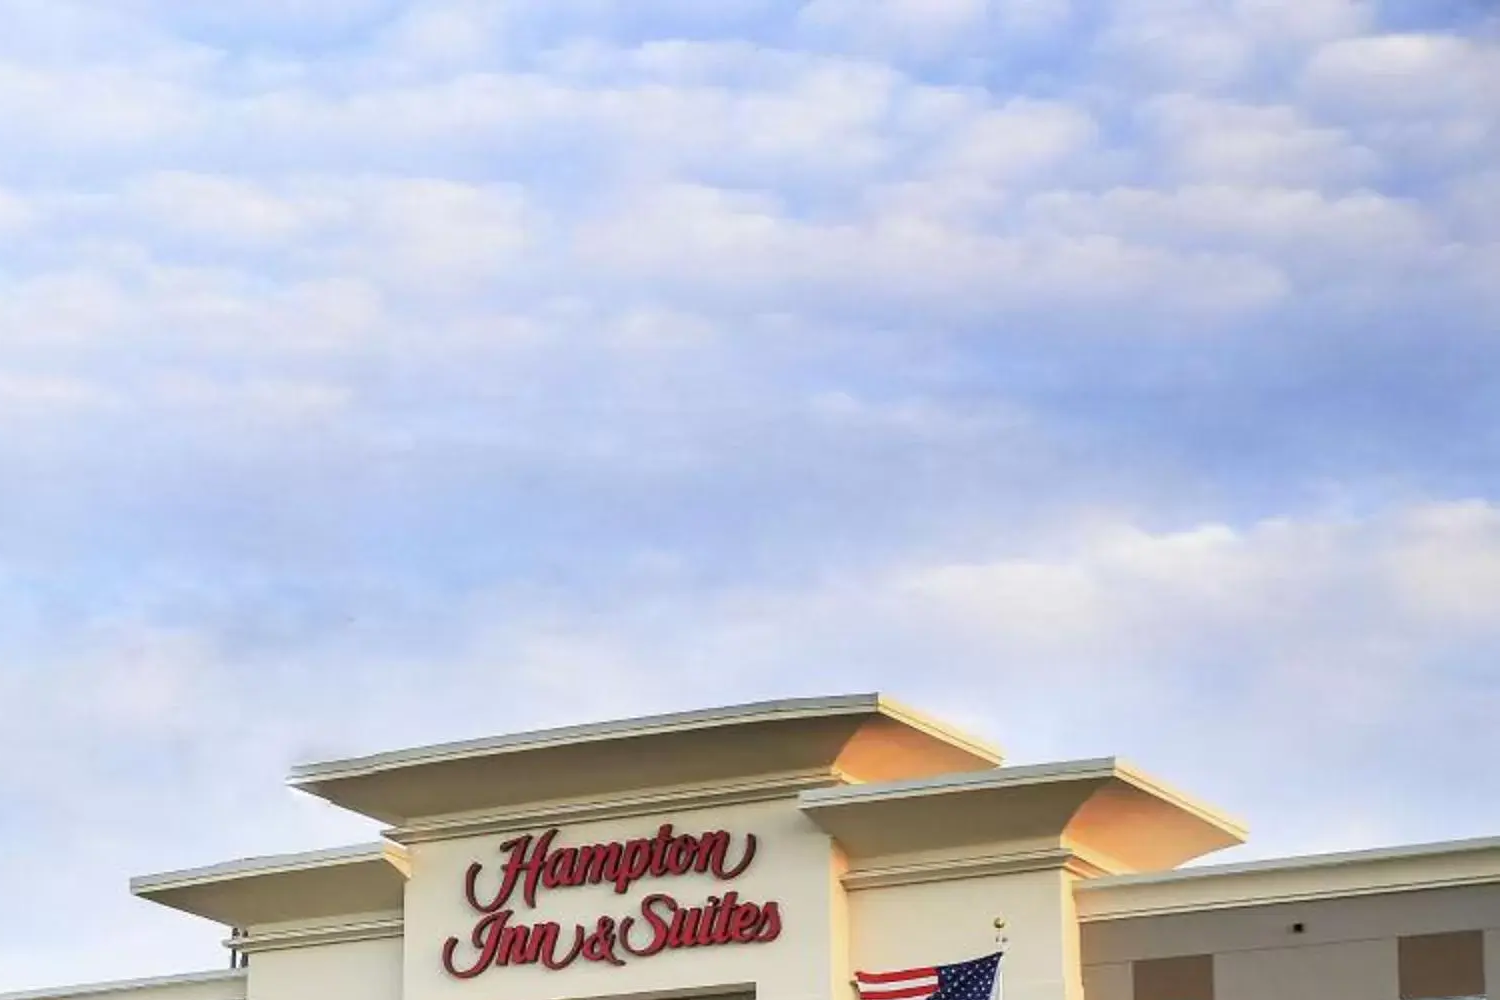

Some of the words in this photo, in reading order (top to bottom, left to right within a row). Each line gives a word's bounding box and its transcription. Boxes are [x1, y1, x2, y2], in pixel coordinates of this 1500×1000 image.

[465, 823, 757, 914] Hampton
[442, 909, 585, 979] Inn
[582, 915, 626, 967] &
[620, 891, 783, 957] Suites
